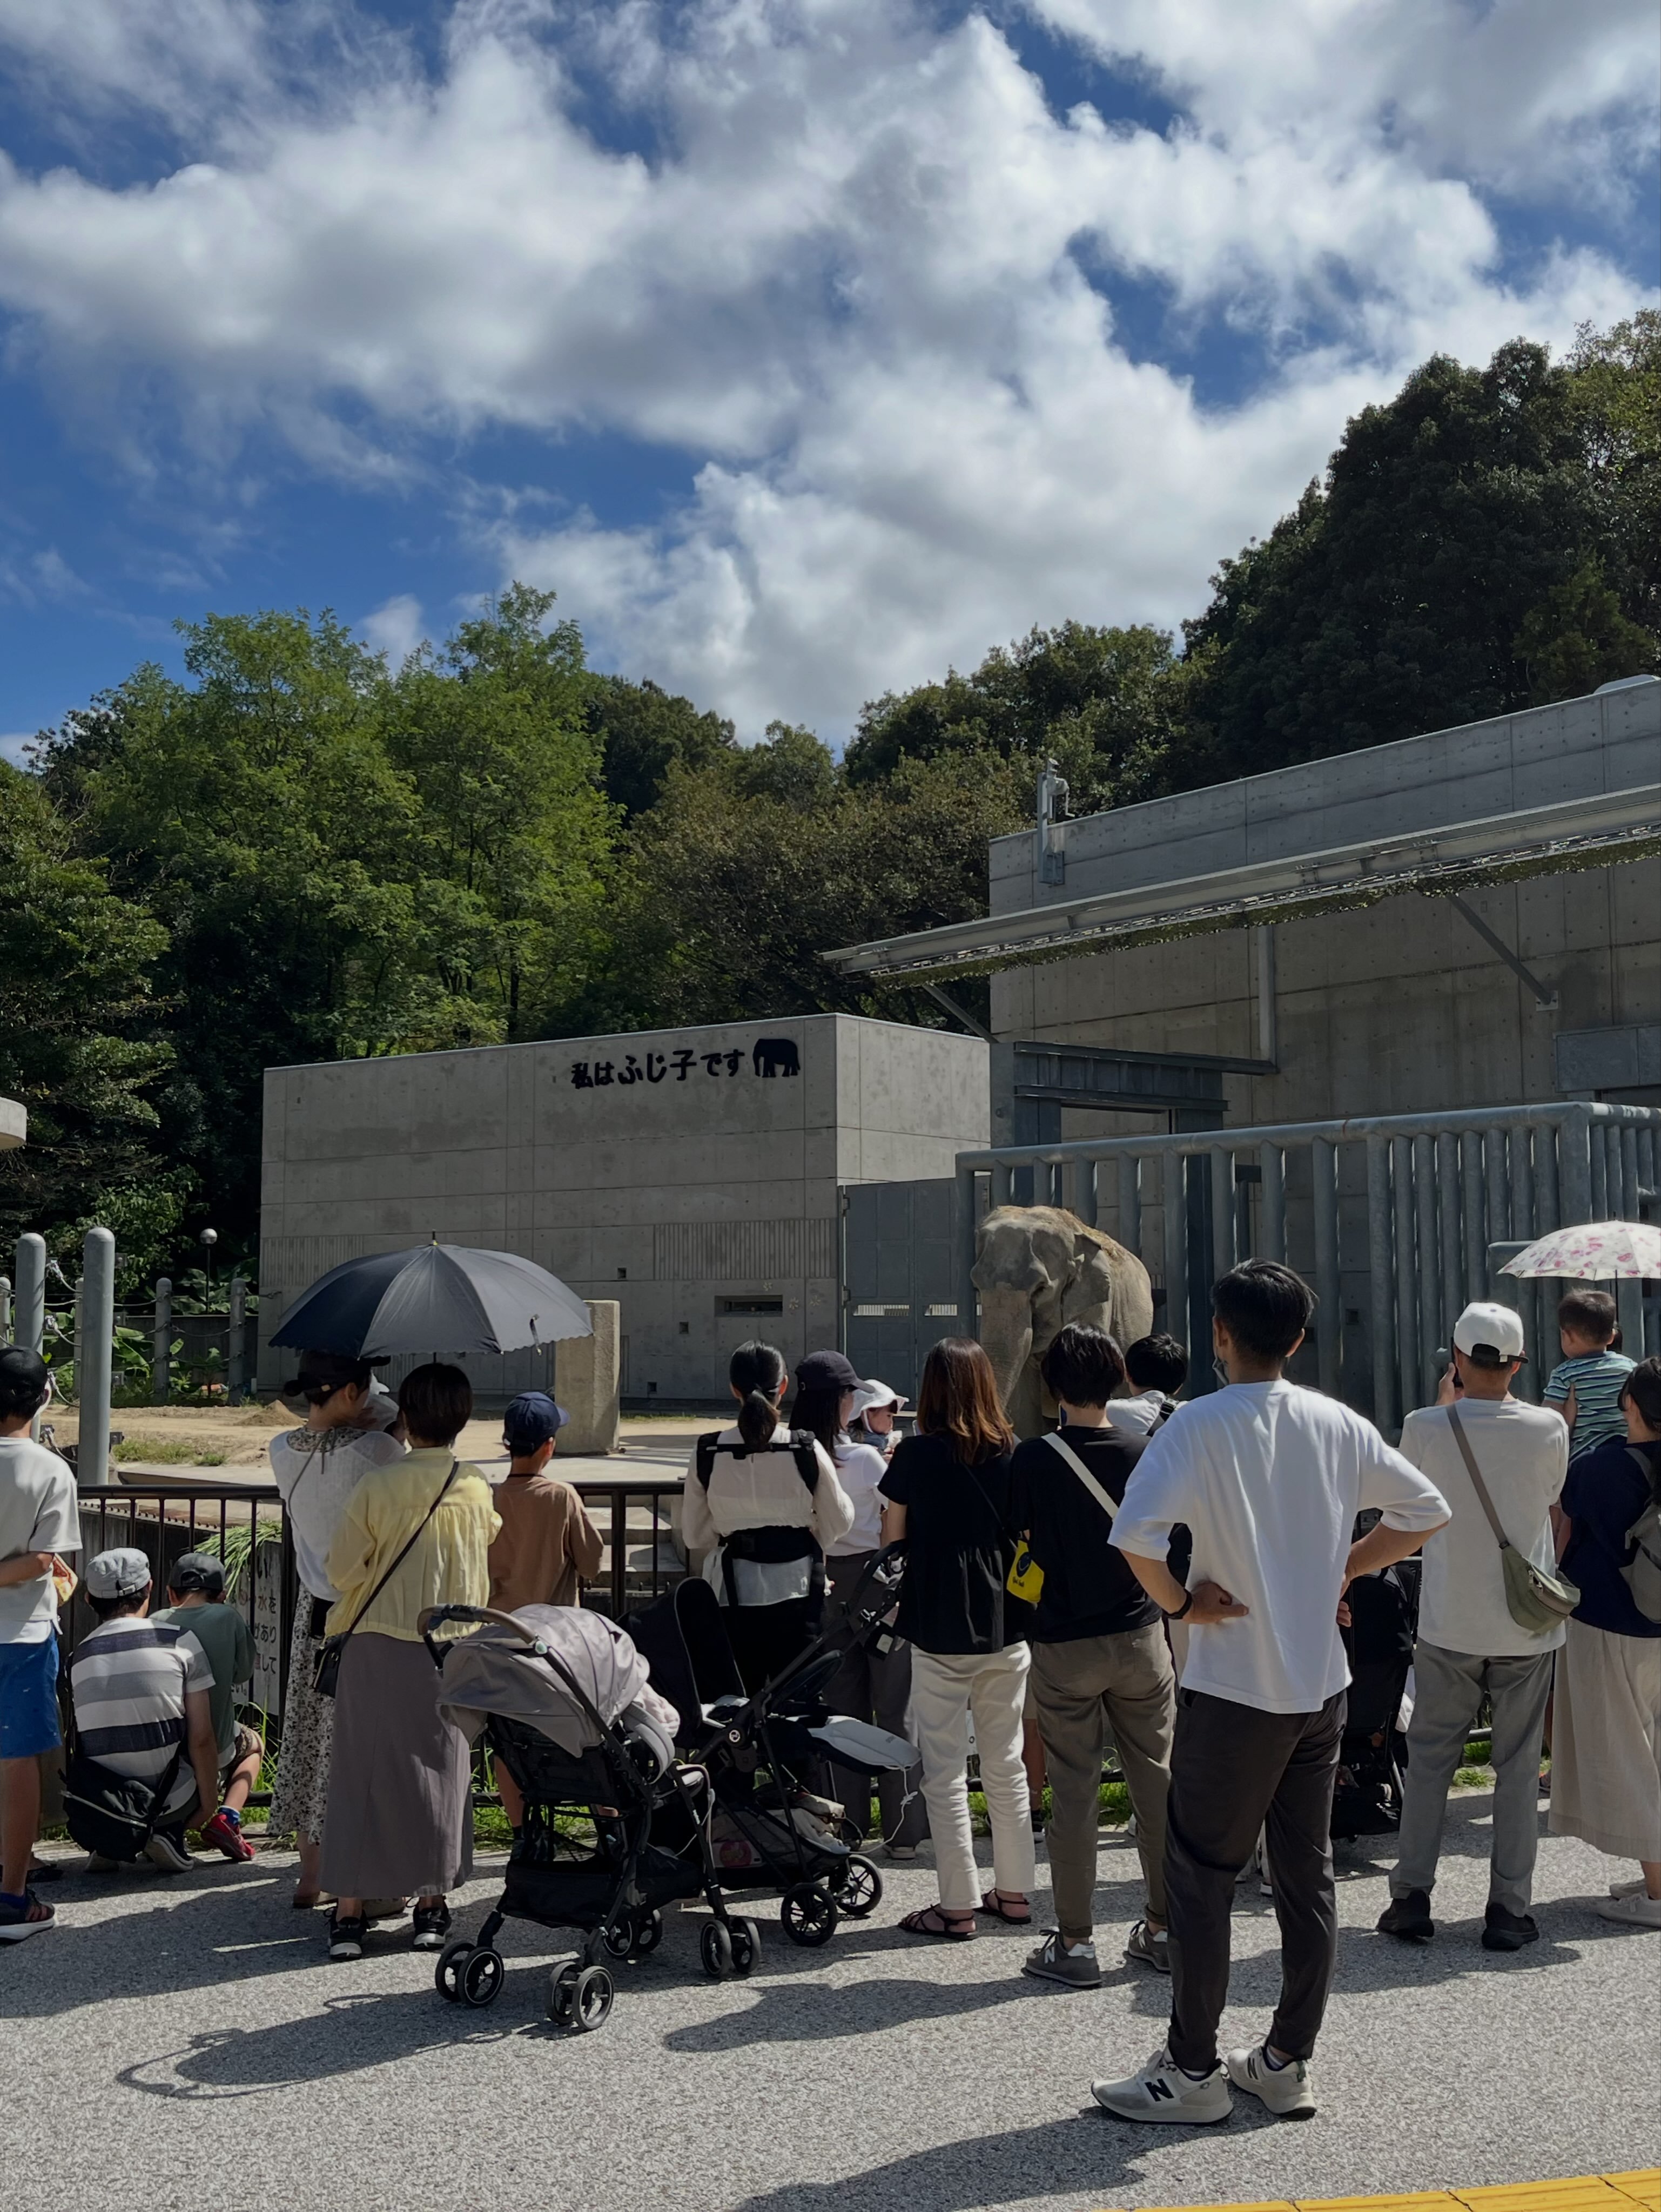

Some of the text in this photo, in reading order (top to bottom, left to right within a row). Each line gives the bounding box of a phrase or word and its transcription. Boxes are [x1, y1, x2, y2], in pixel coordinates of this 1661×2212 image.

[571, 1048, 745, 1089] 私はふじ子です
[1044, 1946, 1055, 1964] N
[1247, 2057, 1259, 2080] N
[1145, 2078, 1175, 2102] N
